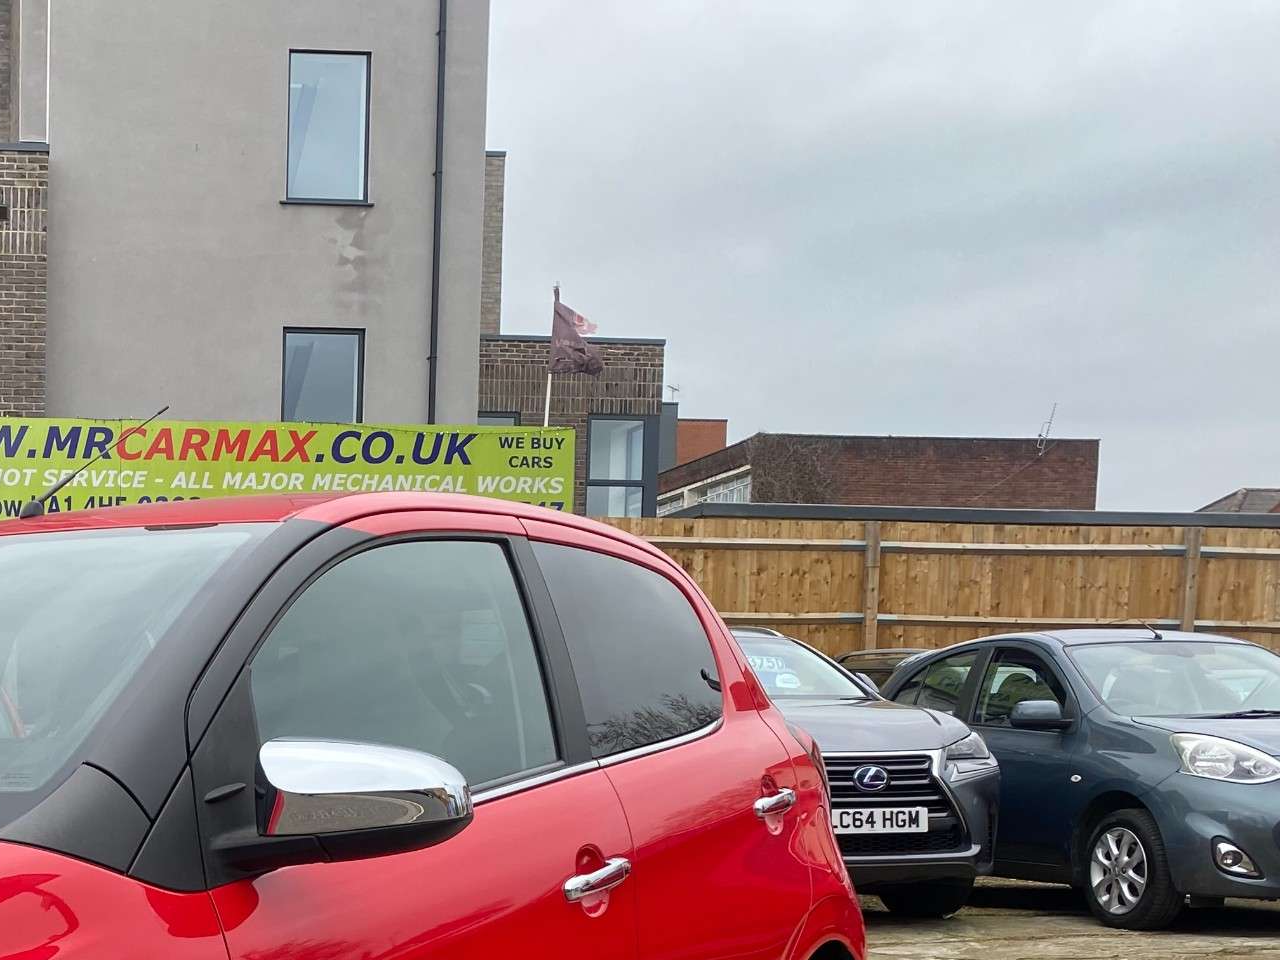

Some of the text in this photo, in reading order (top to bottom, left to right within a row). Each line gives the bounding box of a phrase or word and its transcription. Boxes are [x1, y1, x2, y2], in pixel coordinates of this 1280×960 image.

[499, 437, 565, 450] WE BUY
[508, 456, 553, 469] CARS
[41, 469, 149, 488] SERVICE
[169, 472, 214, 489] ALL
[222, 472, 305, 490] MAJOR
[311, 473, 468, 492] MECHANICAL
[477, 476, 565, 494] WORKS
[882, 810, 920, 828] HGM
